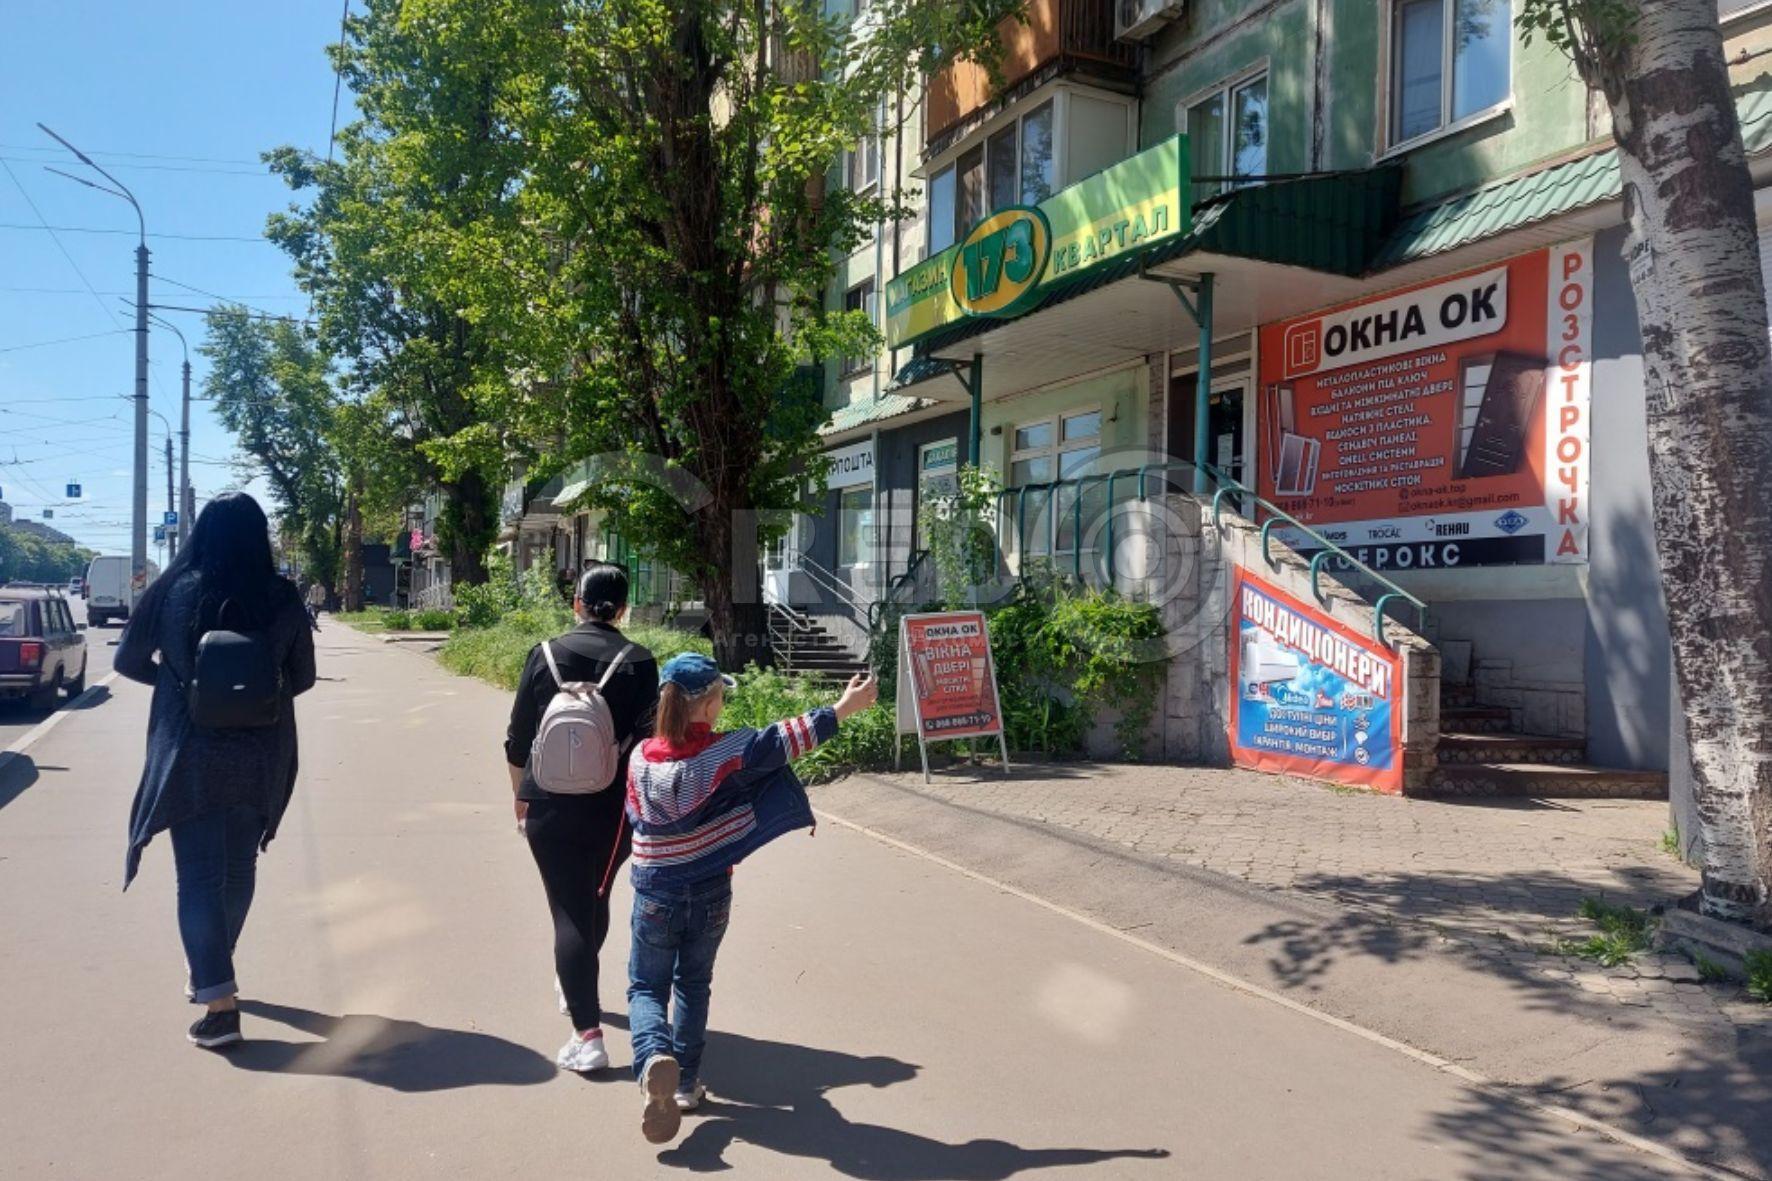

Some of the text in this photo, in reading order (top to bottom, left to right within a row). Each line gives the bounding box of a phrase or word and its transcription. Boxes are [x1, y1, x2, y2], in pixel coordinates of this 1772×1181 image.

[962, 218, 1035, 301] 173
[1053, 203, 1168, 275] КВАРТАЛ
[1323, 283, 1497, 356] ОКНА ОК
[1557, 252, 1583, 556] РОЗСТРОЧКА
[1435, 522, 1470, 537] REHAU
[925, 645, 972, 661] ВІКНА
[926, 624, 978, 638] ОКНА ОК
[1243, 587, 1387, 698] КОНДИЦІОНЕРИ
[934, 660, 970, 675] ДВЕРІ
